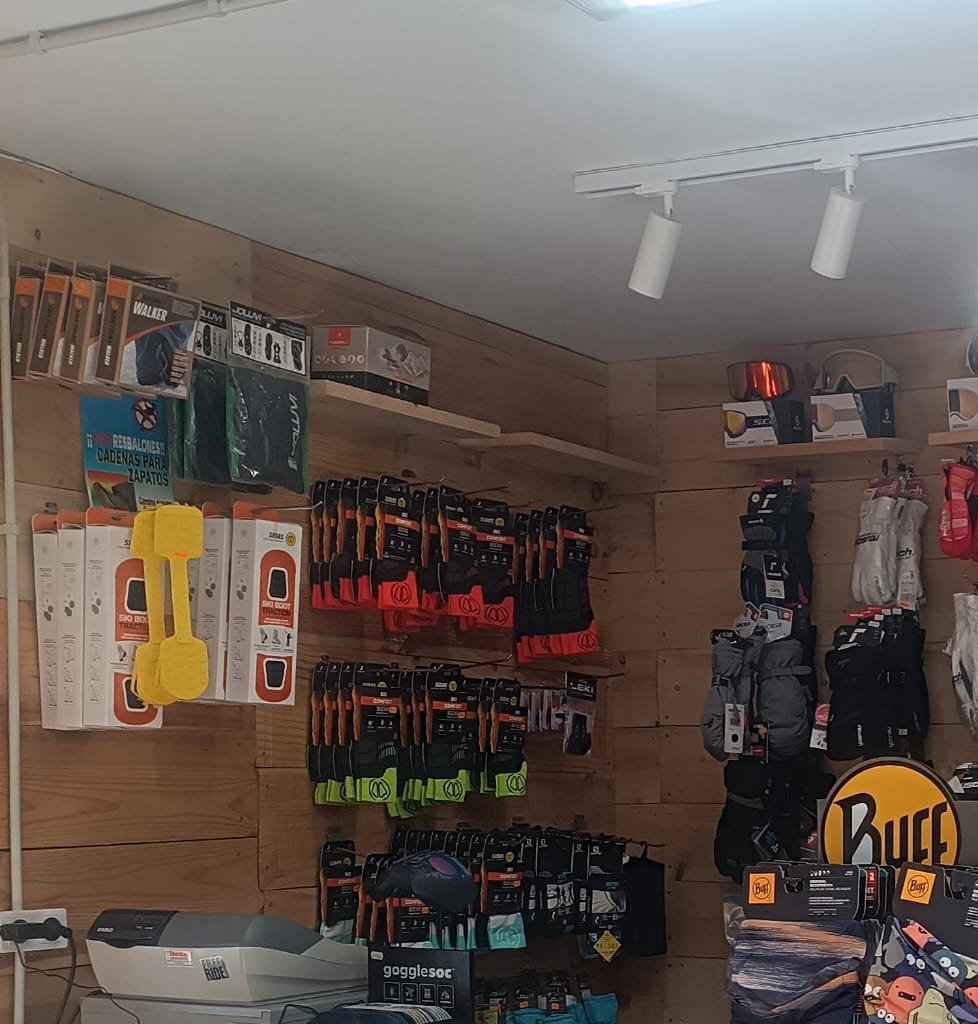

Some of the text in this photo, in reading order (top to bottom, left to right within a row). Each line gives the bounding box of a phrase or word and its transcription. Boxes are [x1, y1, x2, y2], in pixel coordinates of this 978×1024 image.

[133, 301, 168, 321] WALKER
[232, 306, 263, 320] JOLUVI
[97, 448, 168, 471] CADENAS PARA
[128, 469, 169, 487] ZAPATOS
[119, 614, 133, 622] SKI
[201, 957, 225, 968] FREE
[205, 966, 226, 981] RIDE
[383, 964, 452, 979] gogglesoc
